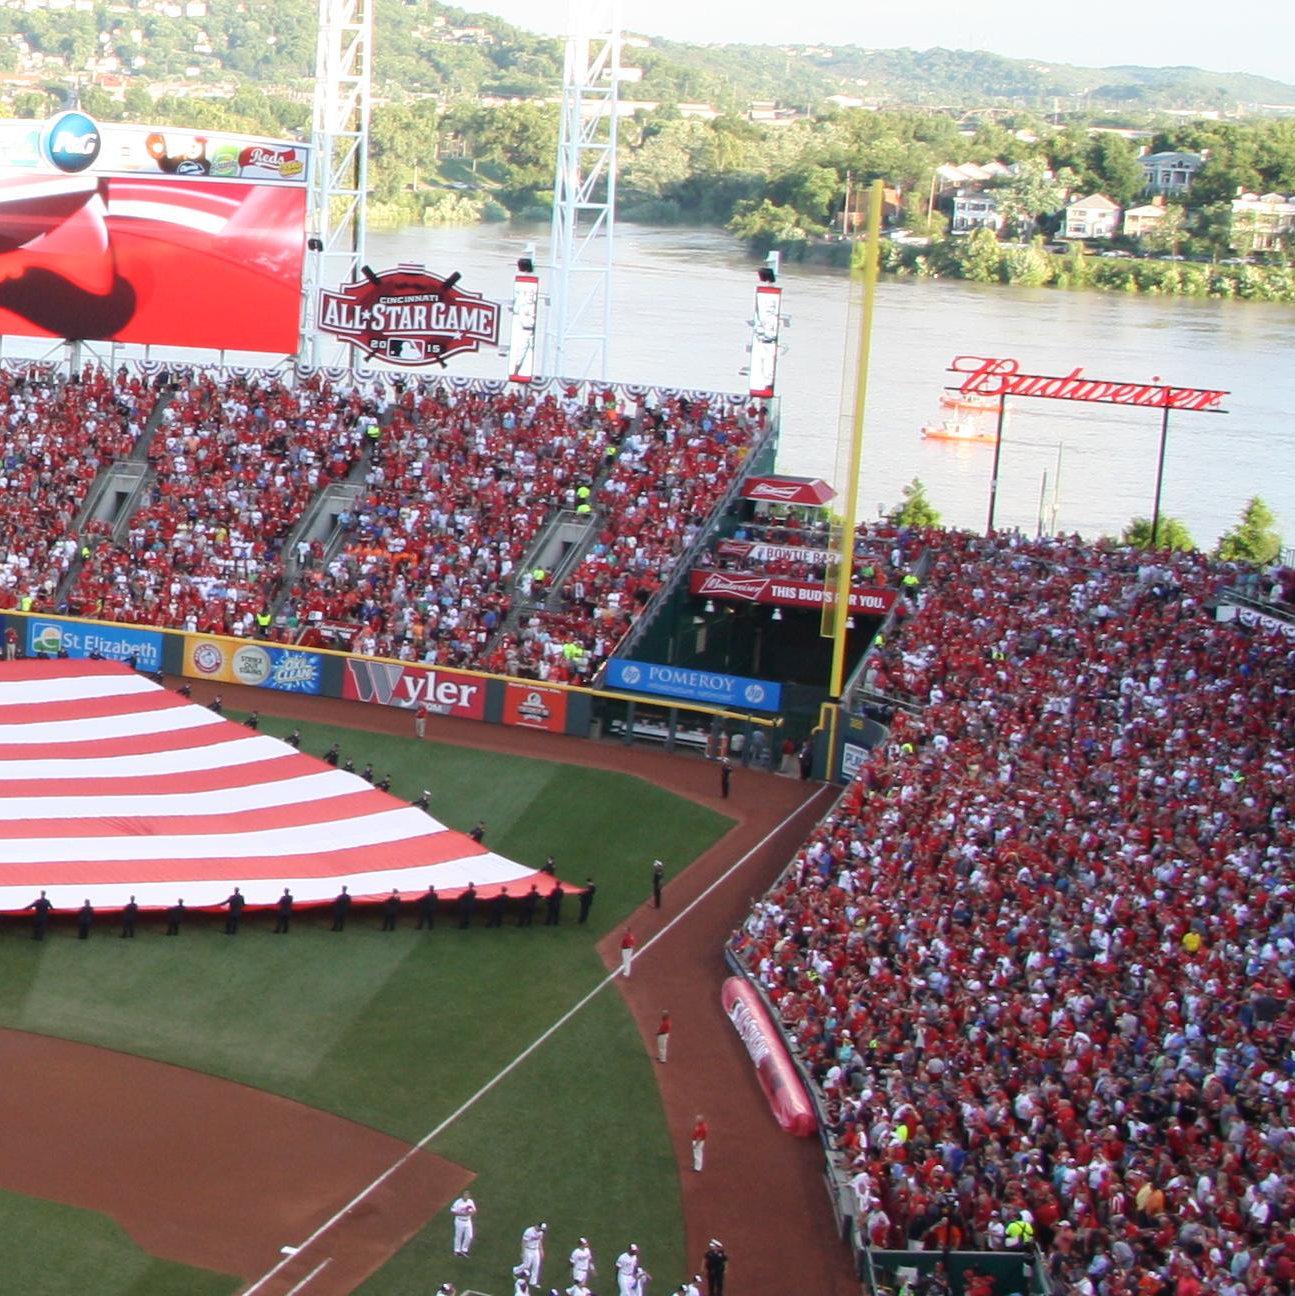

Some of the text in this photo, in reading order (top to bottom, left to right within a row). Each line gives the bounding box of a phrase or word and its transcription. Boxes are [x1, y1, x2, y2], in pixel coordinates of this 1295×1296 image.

[52, 131, 98, 155] P&G
[250, 148, 285, 166] Reds
[379, 294, 439, 305] CINCINNATI
[431, 302, 493, 335] GAME
[952, 355, 1226, 411] Budweiser
[709, 577, 762, 593] Budweiser
[771, 585, 798, 599] THIS
[799, 588, 832, 602] BUD'S
[859, 596, 886, 609] YOU.
[63, 633, 158, 659] St Elizabeth
[346, 657, 477, 708] Wyler
[649, 666, 735, 692] POMEROY
